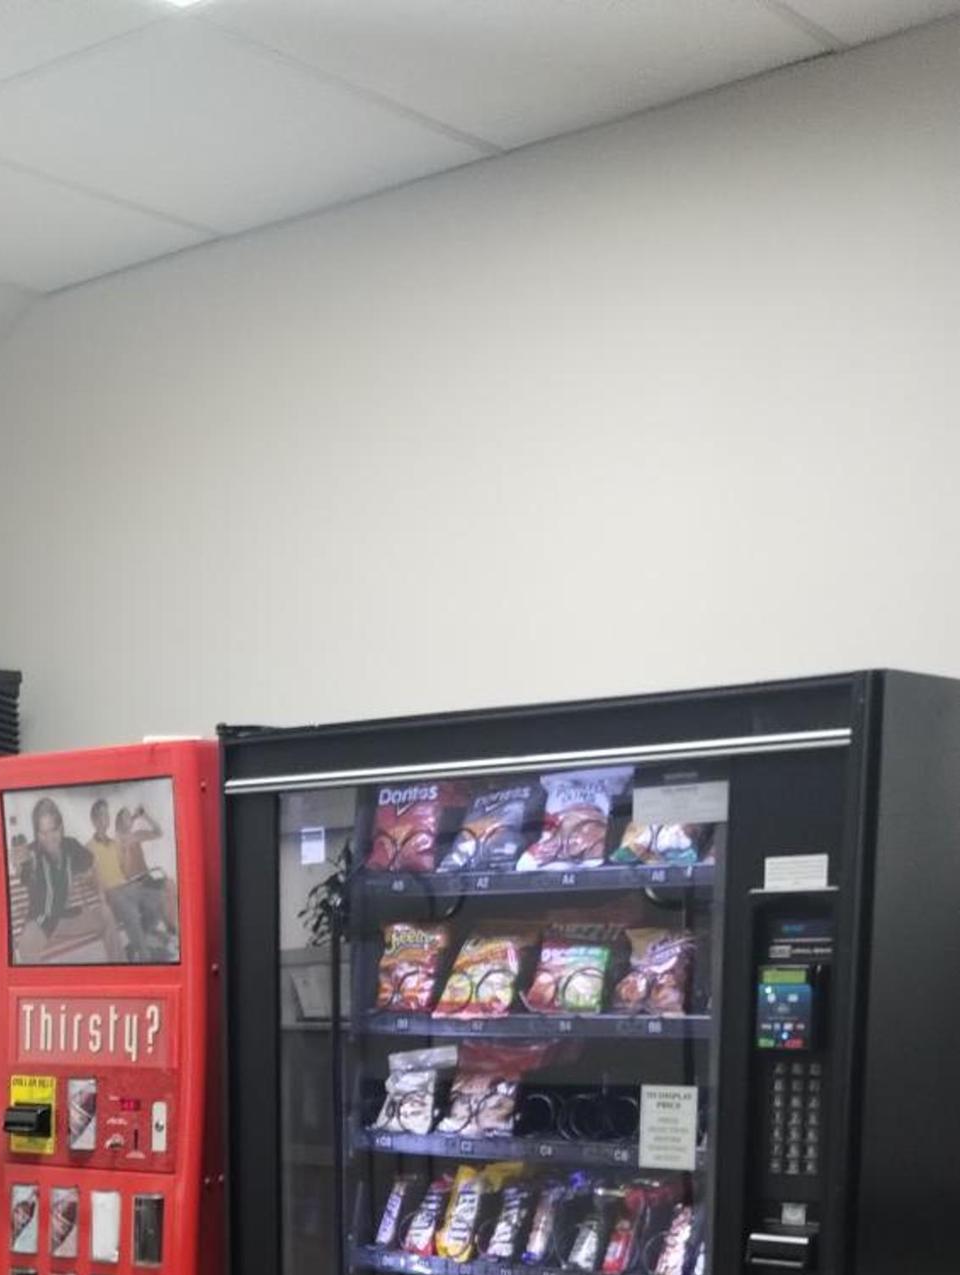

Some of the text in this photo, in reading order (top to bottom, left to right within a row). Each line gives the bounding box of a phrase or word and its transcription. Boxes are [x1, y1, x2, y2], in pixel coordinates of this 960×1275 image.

[378, 785, 439, 806] Doritos
[562, 873, 575, 885] A4
[22, 1004, 161, 1063] Thirsty?
